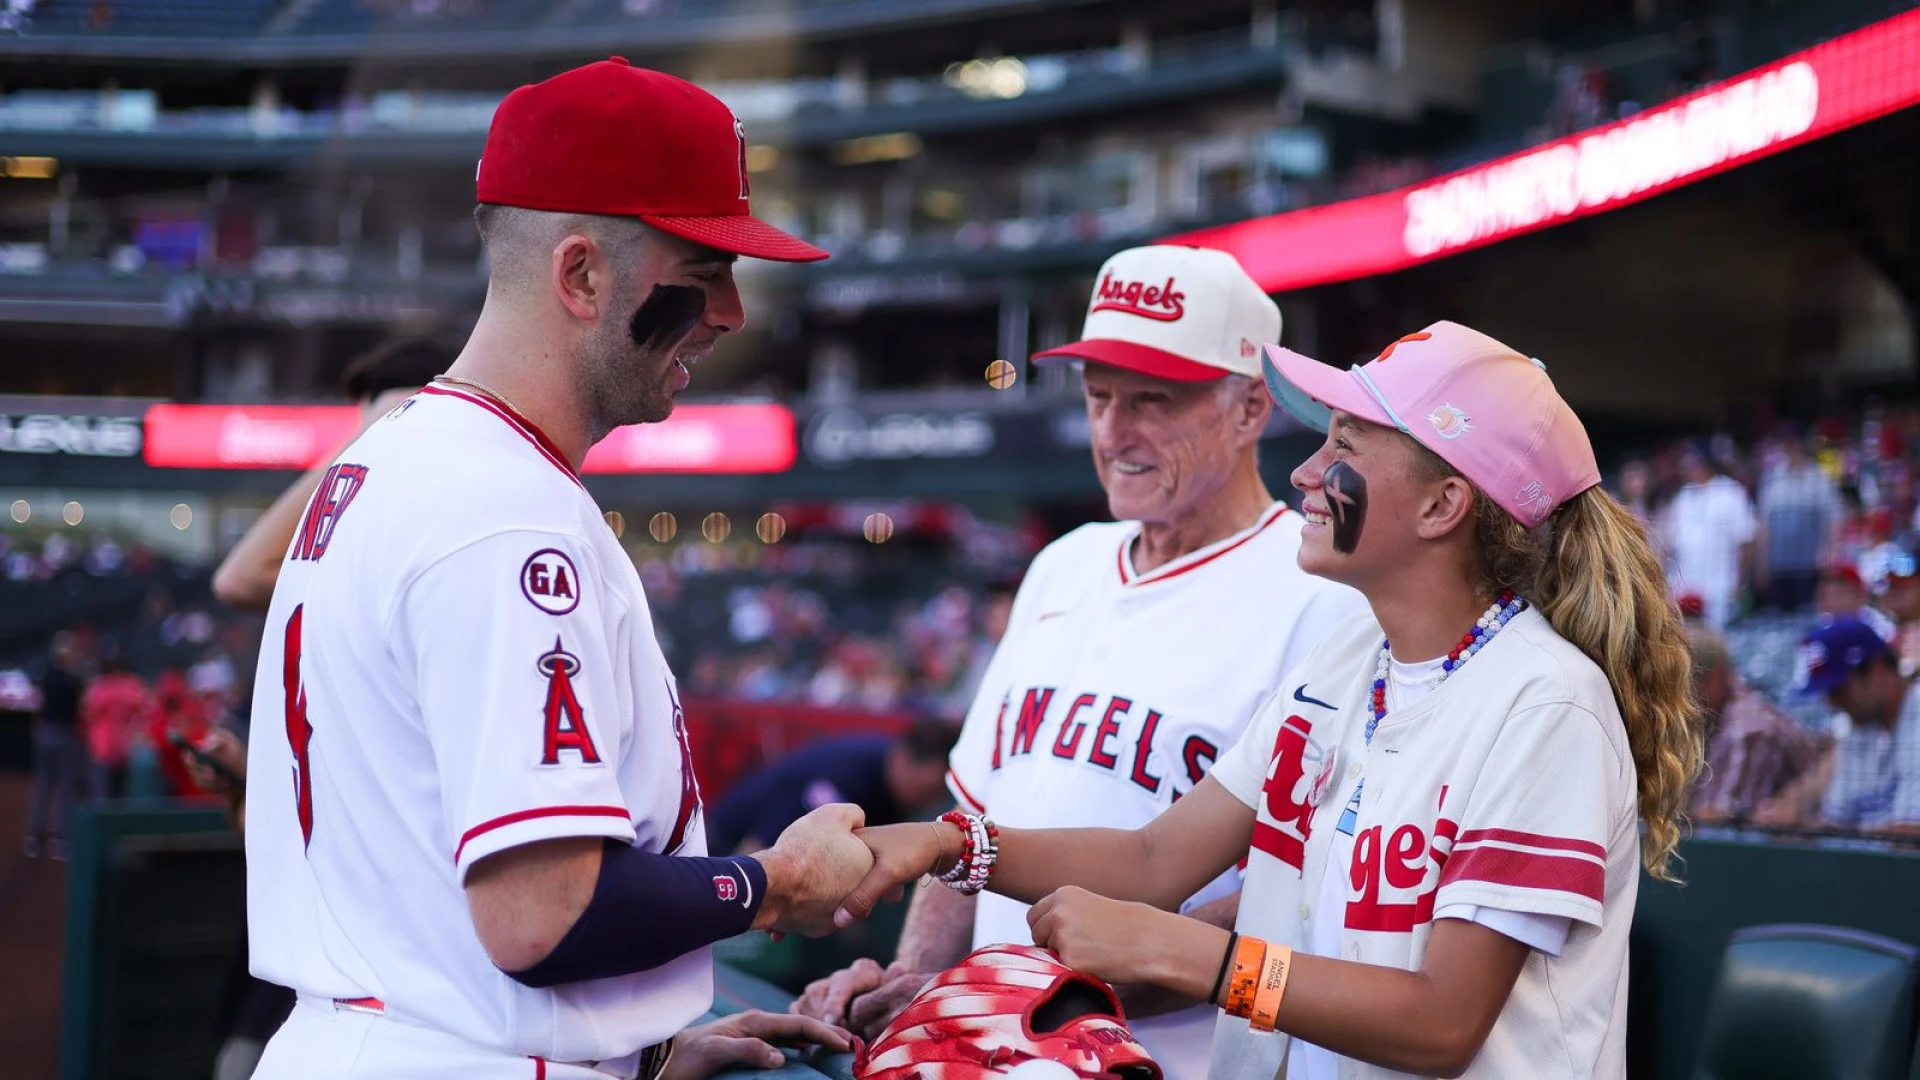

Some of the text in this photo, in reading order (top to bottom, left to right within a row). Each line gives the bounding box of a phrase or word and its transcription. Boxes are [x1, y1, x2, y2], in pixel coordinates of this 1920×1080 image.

[1092, 269, 1186, 322] Angels
[529, 562, 575, 599] GA
[1265, 958, 1278, 990] STADIUM
[1272, 959, 1285, 991] ANGEL
